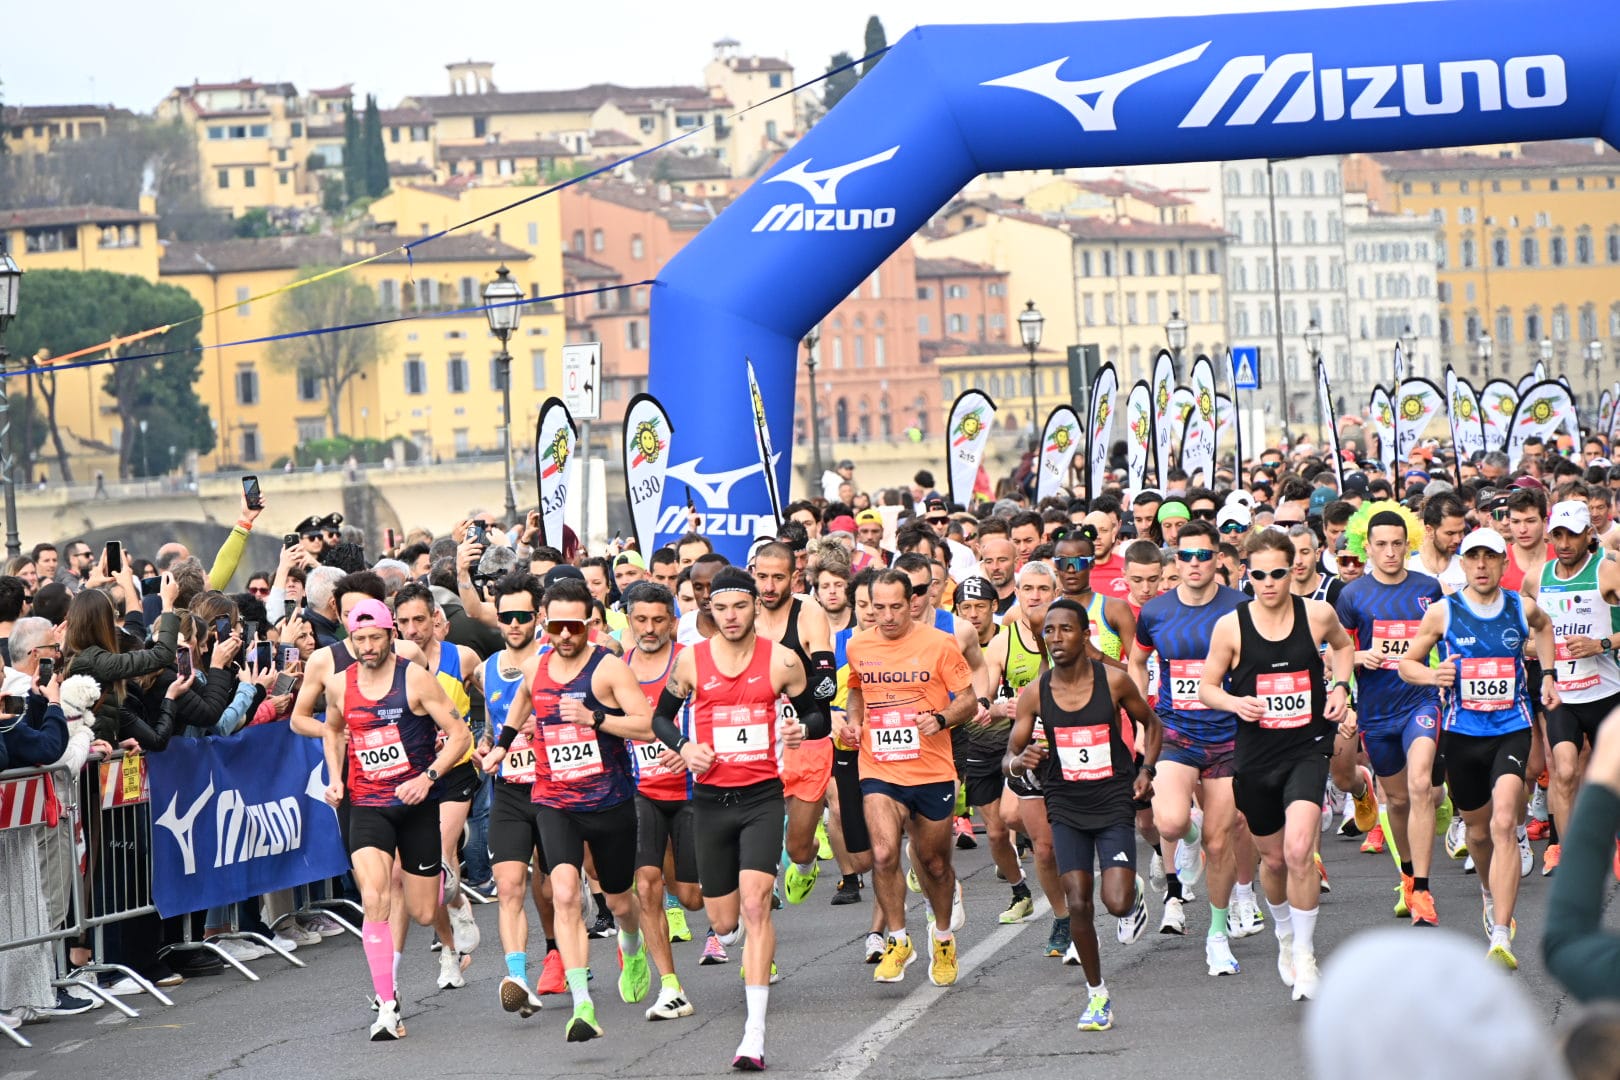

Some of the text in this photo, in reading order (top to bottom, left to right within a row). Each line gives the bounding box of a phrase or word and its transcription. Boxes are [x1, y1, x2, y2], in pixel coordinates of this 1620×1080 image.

[1177, 52, 1568, 129] MIZUNO
[751, 203, 897, 232] MIZUNO
[959, 450, 976, 463] 2:15
[631, 475, 661, 504] 1:30
[1552, 622, 1593, 636] etilar
[1567, 660, 1577, 675] 7
[1176, 679, 1200, 694] 22
[1469, 680, 1508, 696] 1368
[1266, 694, 1305, 711] 1306
[737, 728, 748, 744] 4
[876, 729, 913, 745] 1443
[361, 745, 400, 765] 2060
[551, 743, 593, 764] 2324
[1079, 748, 1090, 764] 3
[214, 788, 302, 868] MIZUNO
